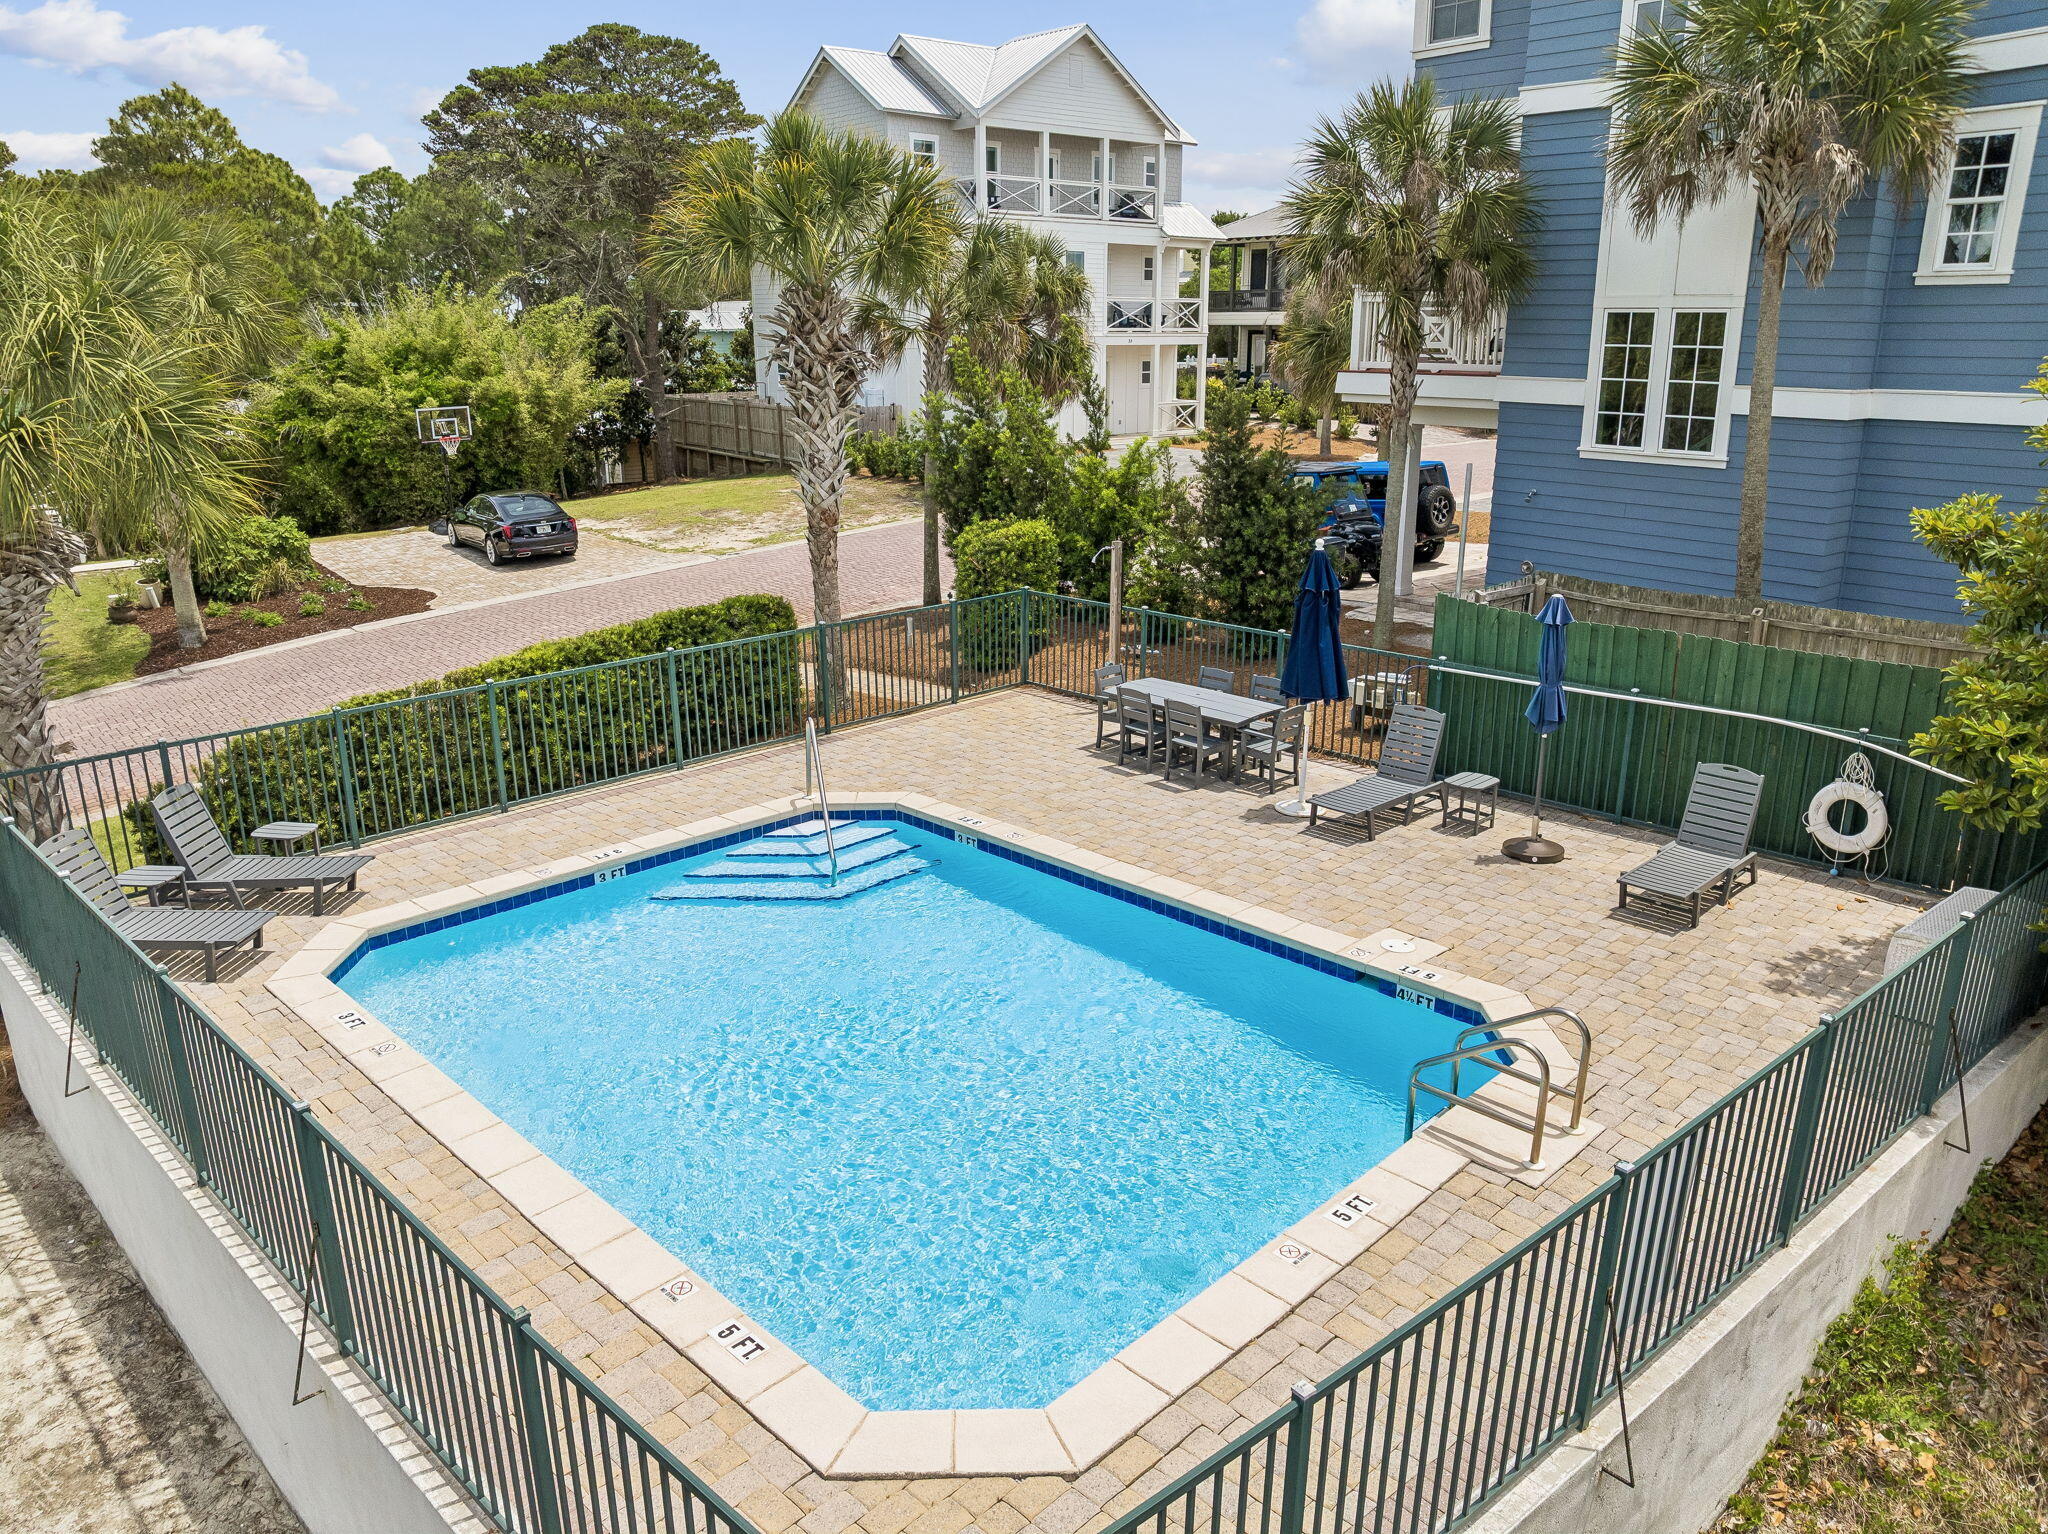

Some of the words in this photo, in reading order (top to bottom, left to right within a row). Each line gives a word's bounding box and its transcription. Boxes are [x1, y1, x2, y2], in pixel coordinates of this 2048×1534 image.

[957, 834, 963, 843] 3
[599, 872, 606, 882] 3
[1422, 972, 1436, 980] 5
[338, 1012, 355, 1020] 3
[1331, 1209, 1352, 1222] 5
[717, 1323, 741, 1339] 5
